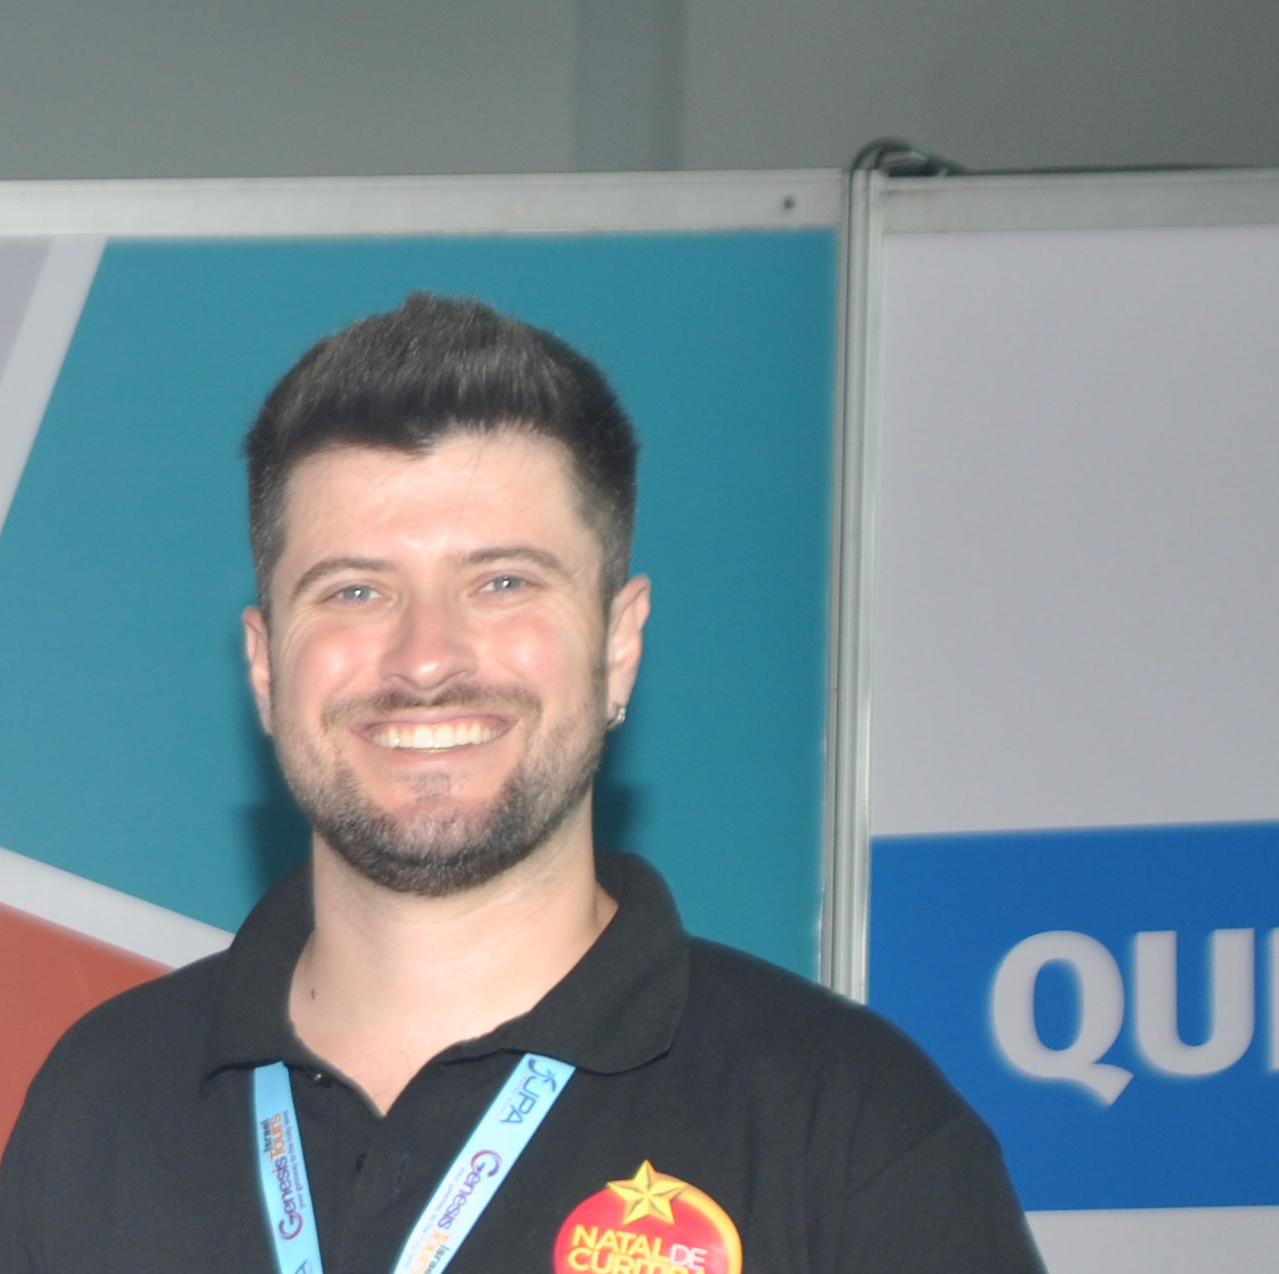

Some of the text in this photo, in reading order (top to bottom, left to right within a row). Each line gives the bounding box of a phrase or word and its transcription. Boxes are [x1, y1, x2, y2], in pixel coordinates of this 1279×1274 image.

[991, 926, 1279, 1107] QU
[259, 1118, 273, 1153] Israel
[266, 1110, 303, 1240] Genesis Tours
[436, 1149, 500, 1228] Genesis
[572, 1224, 707, 1271] NATAL DE
